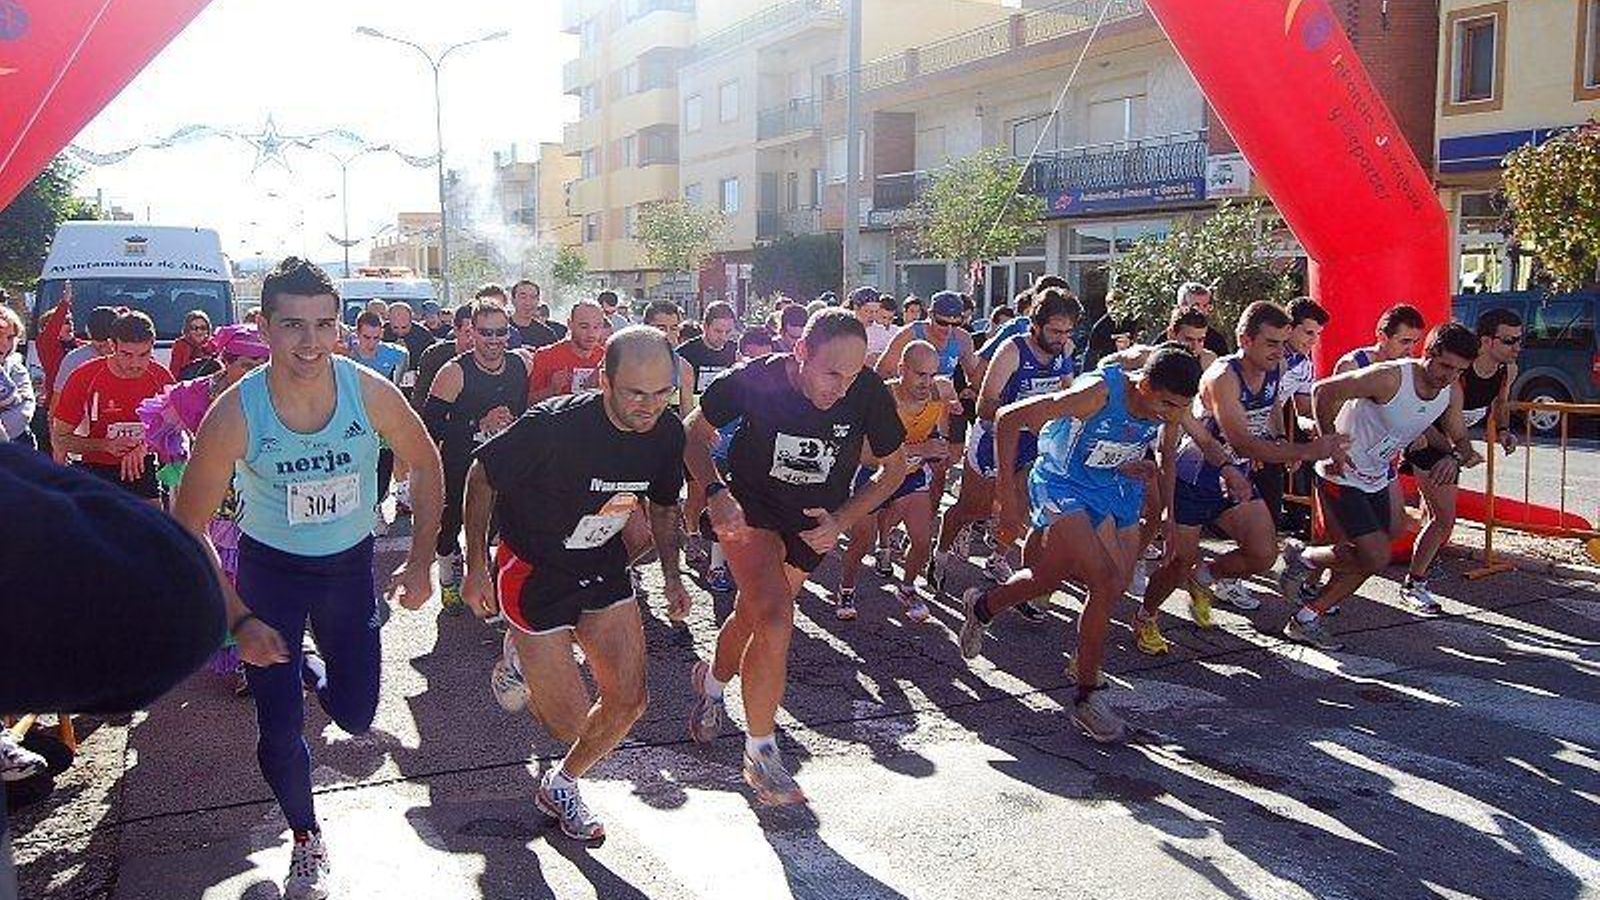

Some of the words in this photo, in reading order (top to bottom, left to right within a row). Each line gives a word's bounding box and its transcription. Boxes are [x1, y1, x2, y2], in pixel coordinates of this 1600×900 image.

[158, 260, 175, 269] de
[275, 450, 352, 475] nerja
[305, 493, 337, 517] 304
